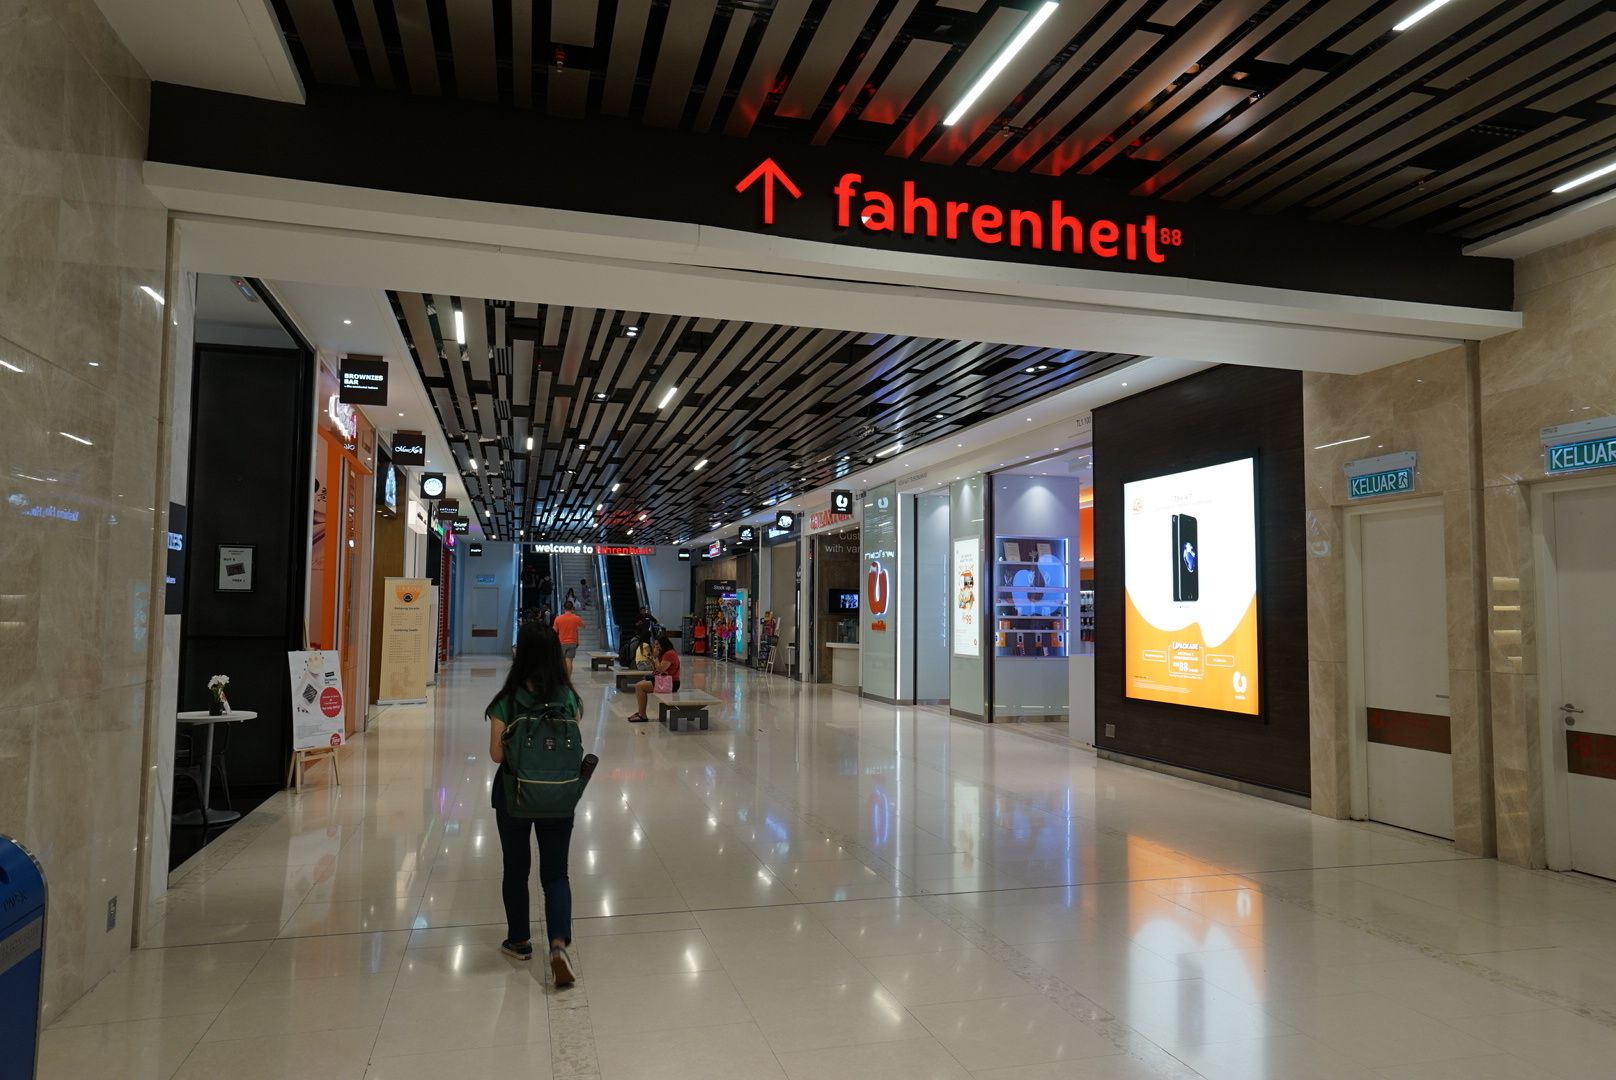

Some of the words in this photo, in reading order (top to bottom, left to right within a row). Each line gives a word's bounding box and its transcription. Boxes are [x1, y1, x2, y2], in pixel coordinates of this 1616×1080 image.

[834, 173, 1165, 263] fahrenheit
[344, 373, 384, 381] BROWNIES
[1551, 440, 1616, 469] KELUAR
[1352, 473, 1396, 496] KELUAR
[535, 543, 581, 554] welcome
[583, 544, 593, 554] to
[825, 544, 844, 553] with
